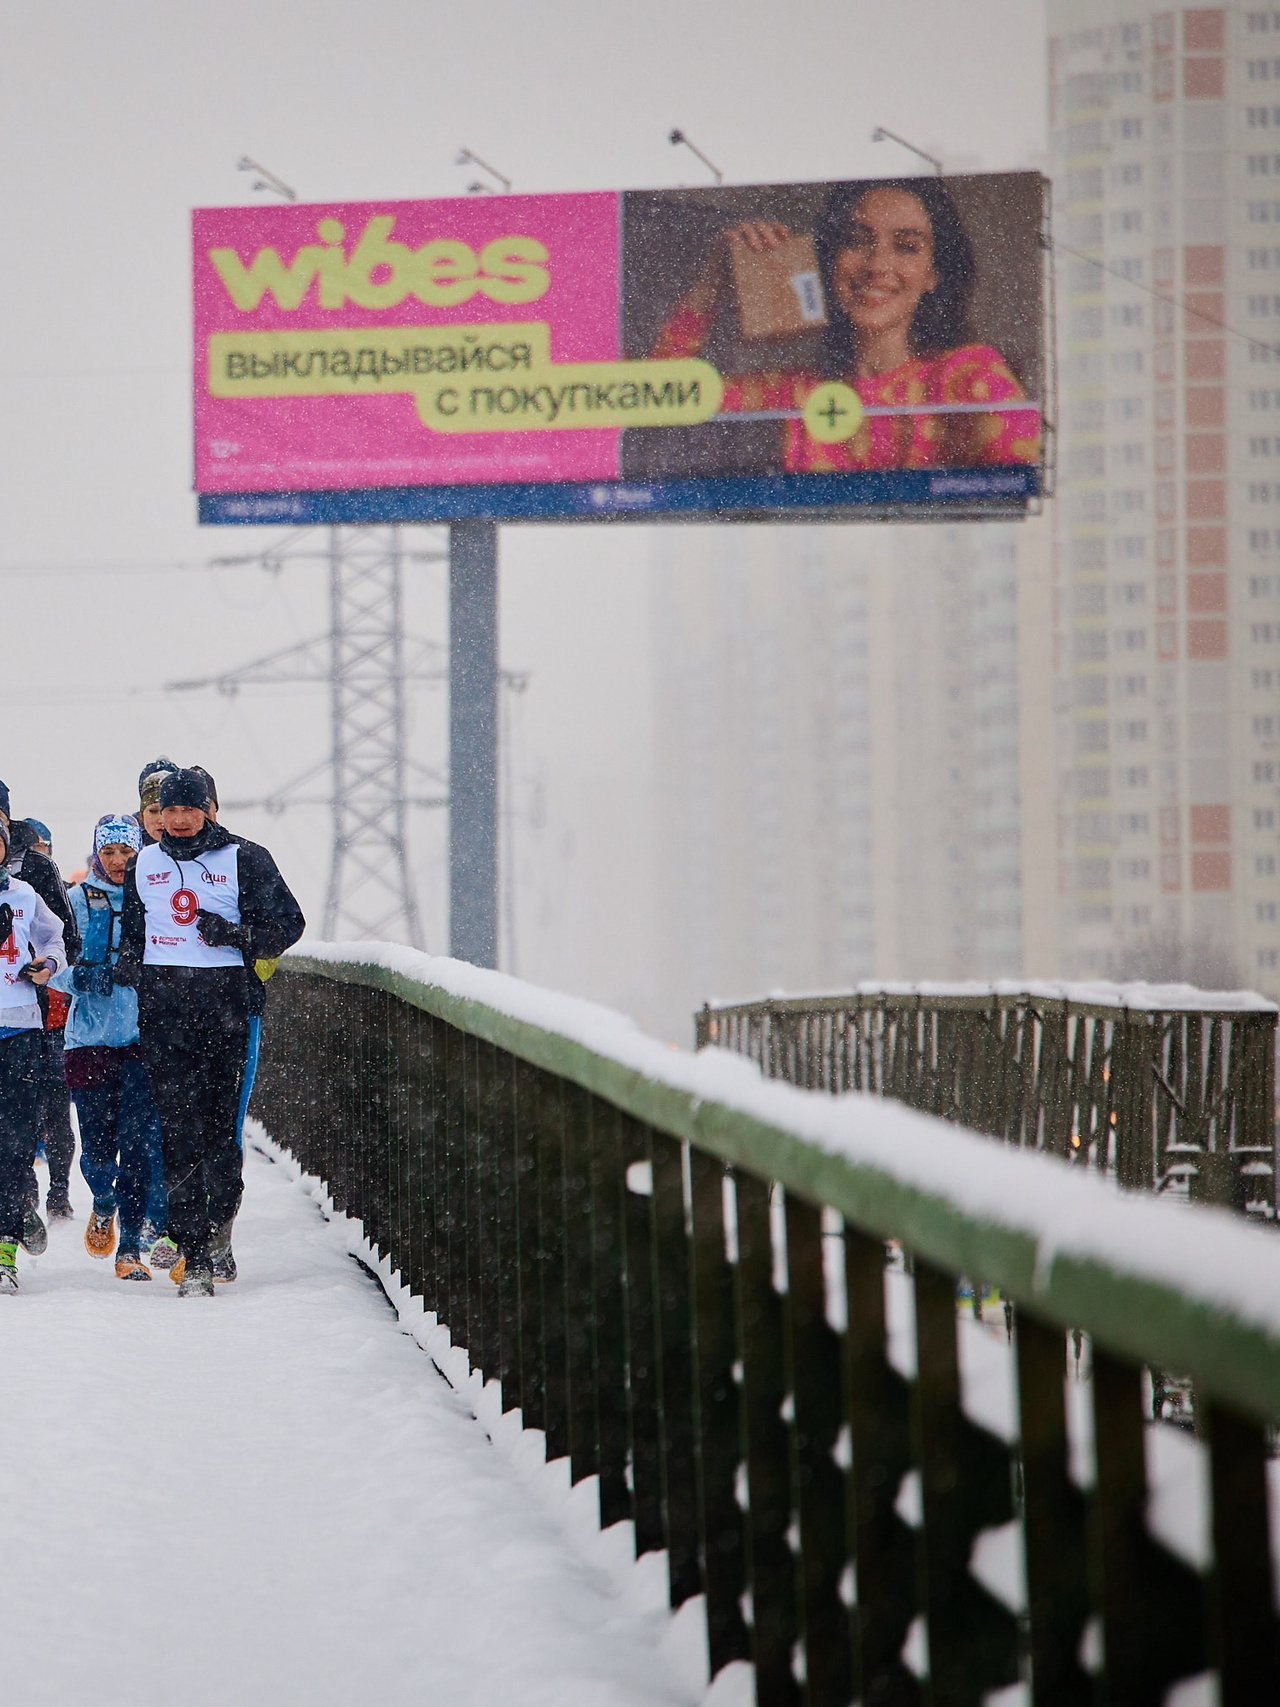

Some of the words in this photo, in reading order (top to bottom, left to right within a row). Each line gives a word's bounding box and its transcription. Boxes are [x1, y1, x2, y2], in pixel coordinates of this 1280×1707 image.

[208, 214, 550, 312] wibes
[225, 333, 533, 383] выкладывайся
[435, 388, 460, 416] с
[470, 380, 702, 422] покупками
[170, 888, 199, 926] 9
